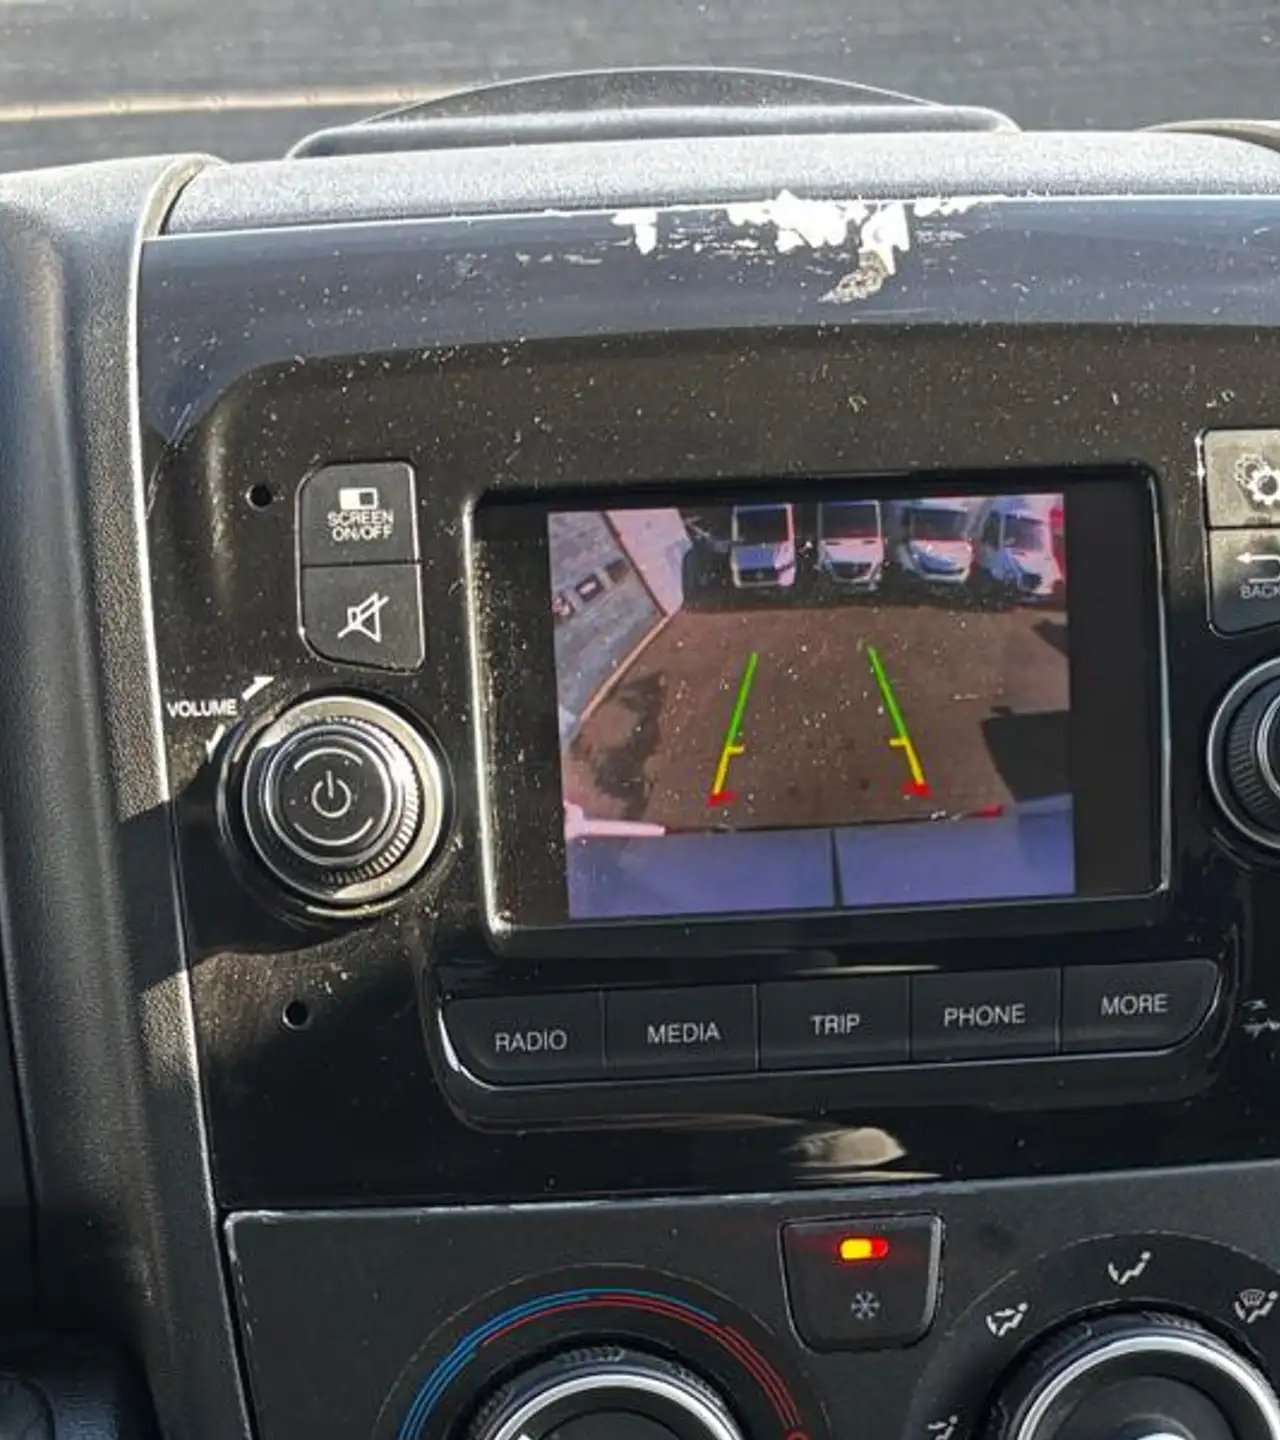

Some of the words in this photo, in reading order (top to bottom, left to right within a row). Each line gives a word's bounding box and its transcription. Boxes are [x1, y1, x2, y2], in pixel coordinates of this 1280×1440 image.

[327, 510, 394, 527] SCREEN
[331, 525, 394, 542] ON/OFF
[166, 698, 238, 719] VOLUME
[943, 1003, 1026, 1028] PHONE
[1100, 992, 1169, 1017] MORE
[646, 1021, 721, 1045] MEDIA
[810, 1013, 861, 1035] TRIP
[494, 1028, 568, 1053] RADIO
